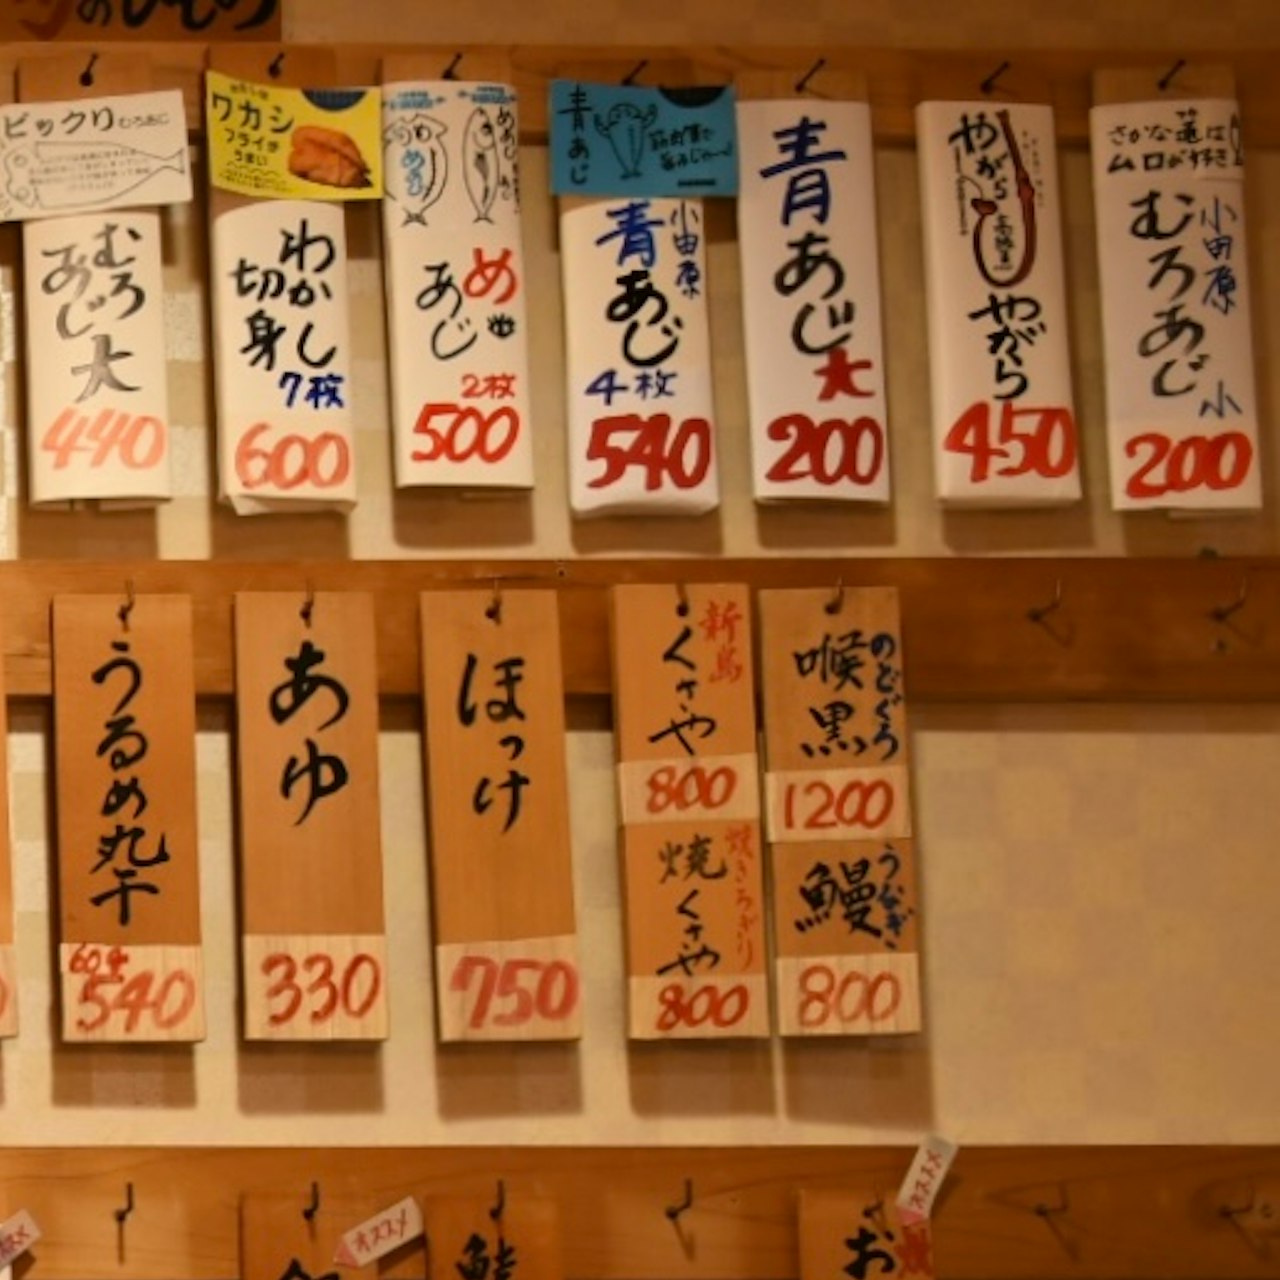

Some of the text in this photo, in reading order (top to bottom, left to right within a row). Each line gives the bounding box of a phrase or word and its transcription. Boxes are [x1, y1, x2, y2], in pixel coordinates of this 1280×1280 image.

[594, 201, 688, 368] 青あじ
[1200, 198, 1238, 315] 小田原
[227, 257, 288, 370] 切身
[968, 294, 1046, 401] やがら
[42, 408, 168, 470] 440
[233, 422, 351, 488] 600
[410, 402, 521, 463] 500
[586, 413, 712, 490] 540
[767, 414, 883, 485] 200
[944, 401, 1075, 482] 450
[1124, 432, 1252, 499] 200
[648, 626, 717, 756] くさや
[267, 640, 350, 828] あゆ
[457, 653, 530, 833] ほっけ
[90, 641, 172, 926] うるめ丸干
[646, 766, 737, 812] 800
[783, 780, 895, 829] 1200
[76, 970, 196, 1032] 540
[261, 954, 382, 1025] 330
[450, 956, 578, 1028] 750
[657, 985, 748, 1031] 800
[797, 965, 902, 1027] 800
[350, 1210, 408, 1254] オススメ
